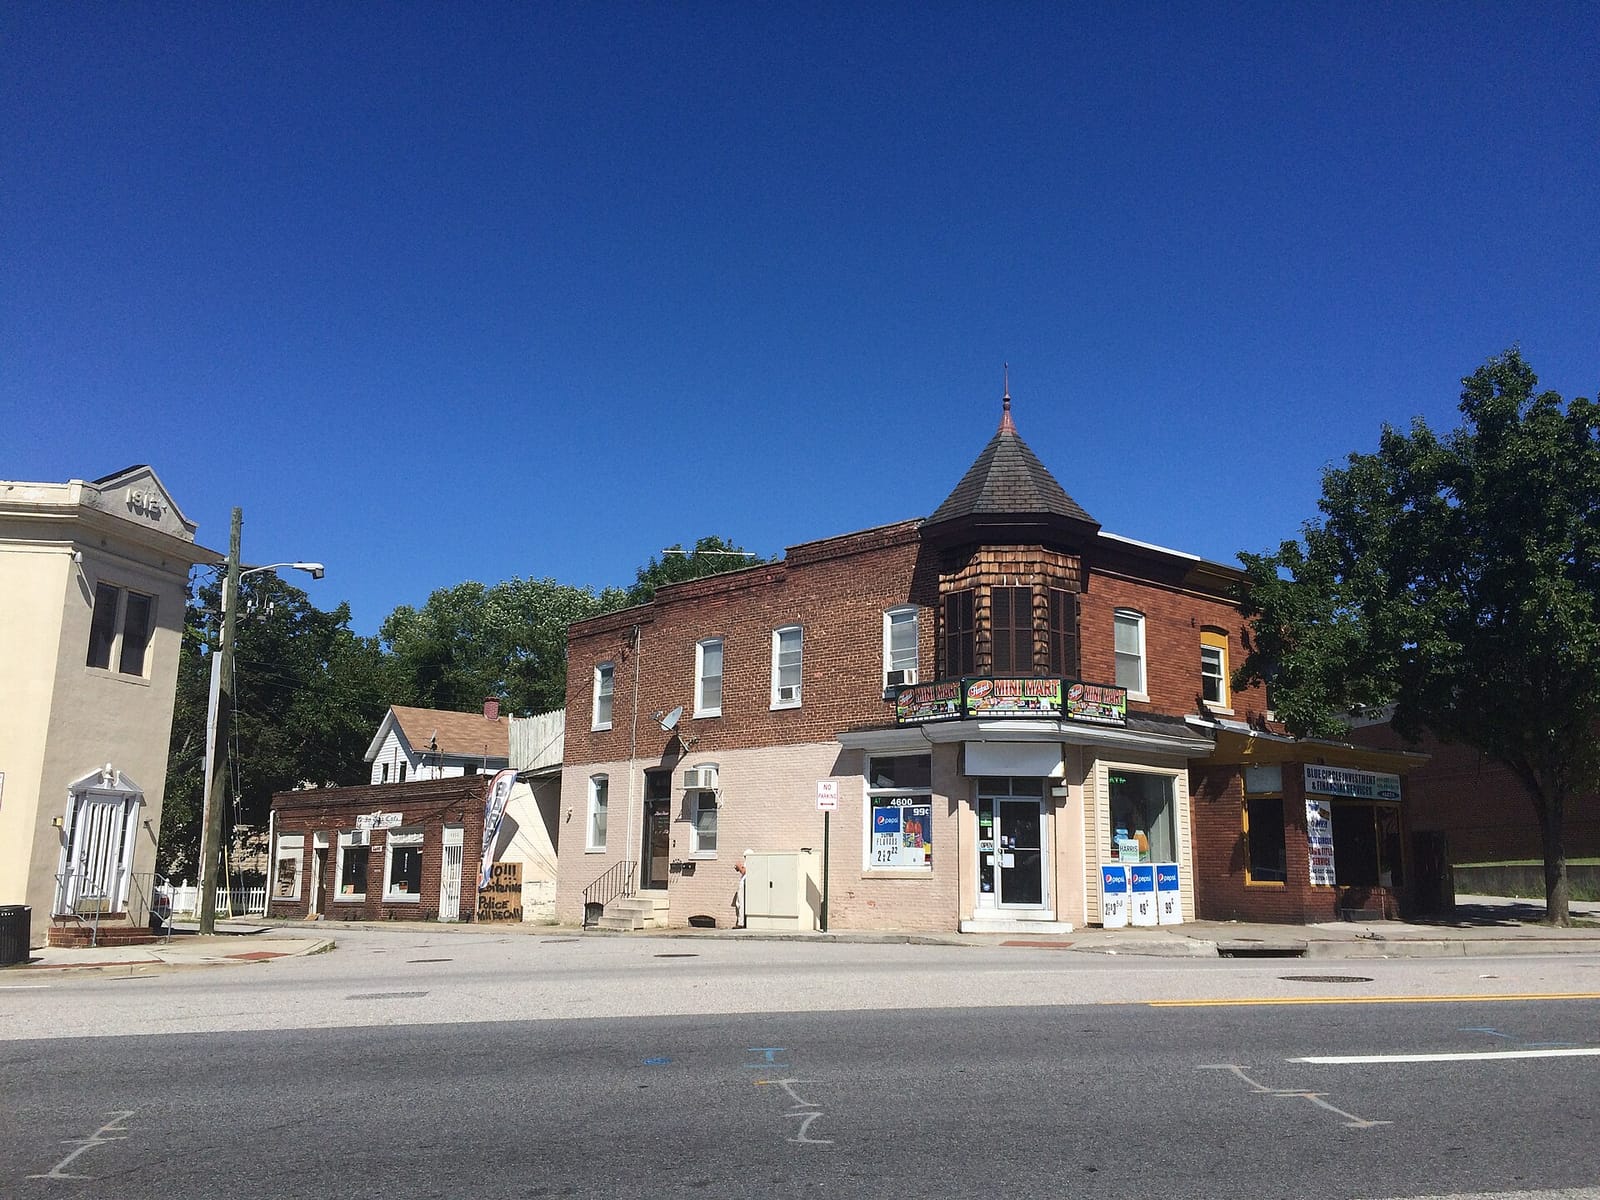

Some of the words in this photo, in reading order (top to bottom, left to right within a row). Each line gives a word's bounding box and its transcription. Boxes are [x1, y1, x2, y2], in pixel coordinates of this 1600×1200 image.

[915, 687, 935, 702] MINI
[935, 682, 958, 699] MART
[994, 680, 1022, 696] MINI
[1025, 680, 1058, 696] MART
[1084, 685, 1101, 703] MINI
[1102, 688, 1124, 705] MART
[1306, 767, 1321, 779] BLUE
[1321, 769, 1341, 783] CIRCLE
[890, 798, 912, 806] 4600
[885, 817, 898, 825] pepsi
[1112, 876, 1125, 884] pepsi
[1138, 875, 1151, 883] pepsi
[1163, 874, 1176, 882] pepsi
